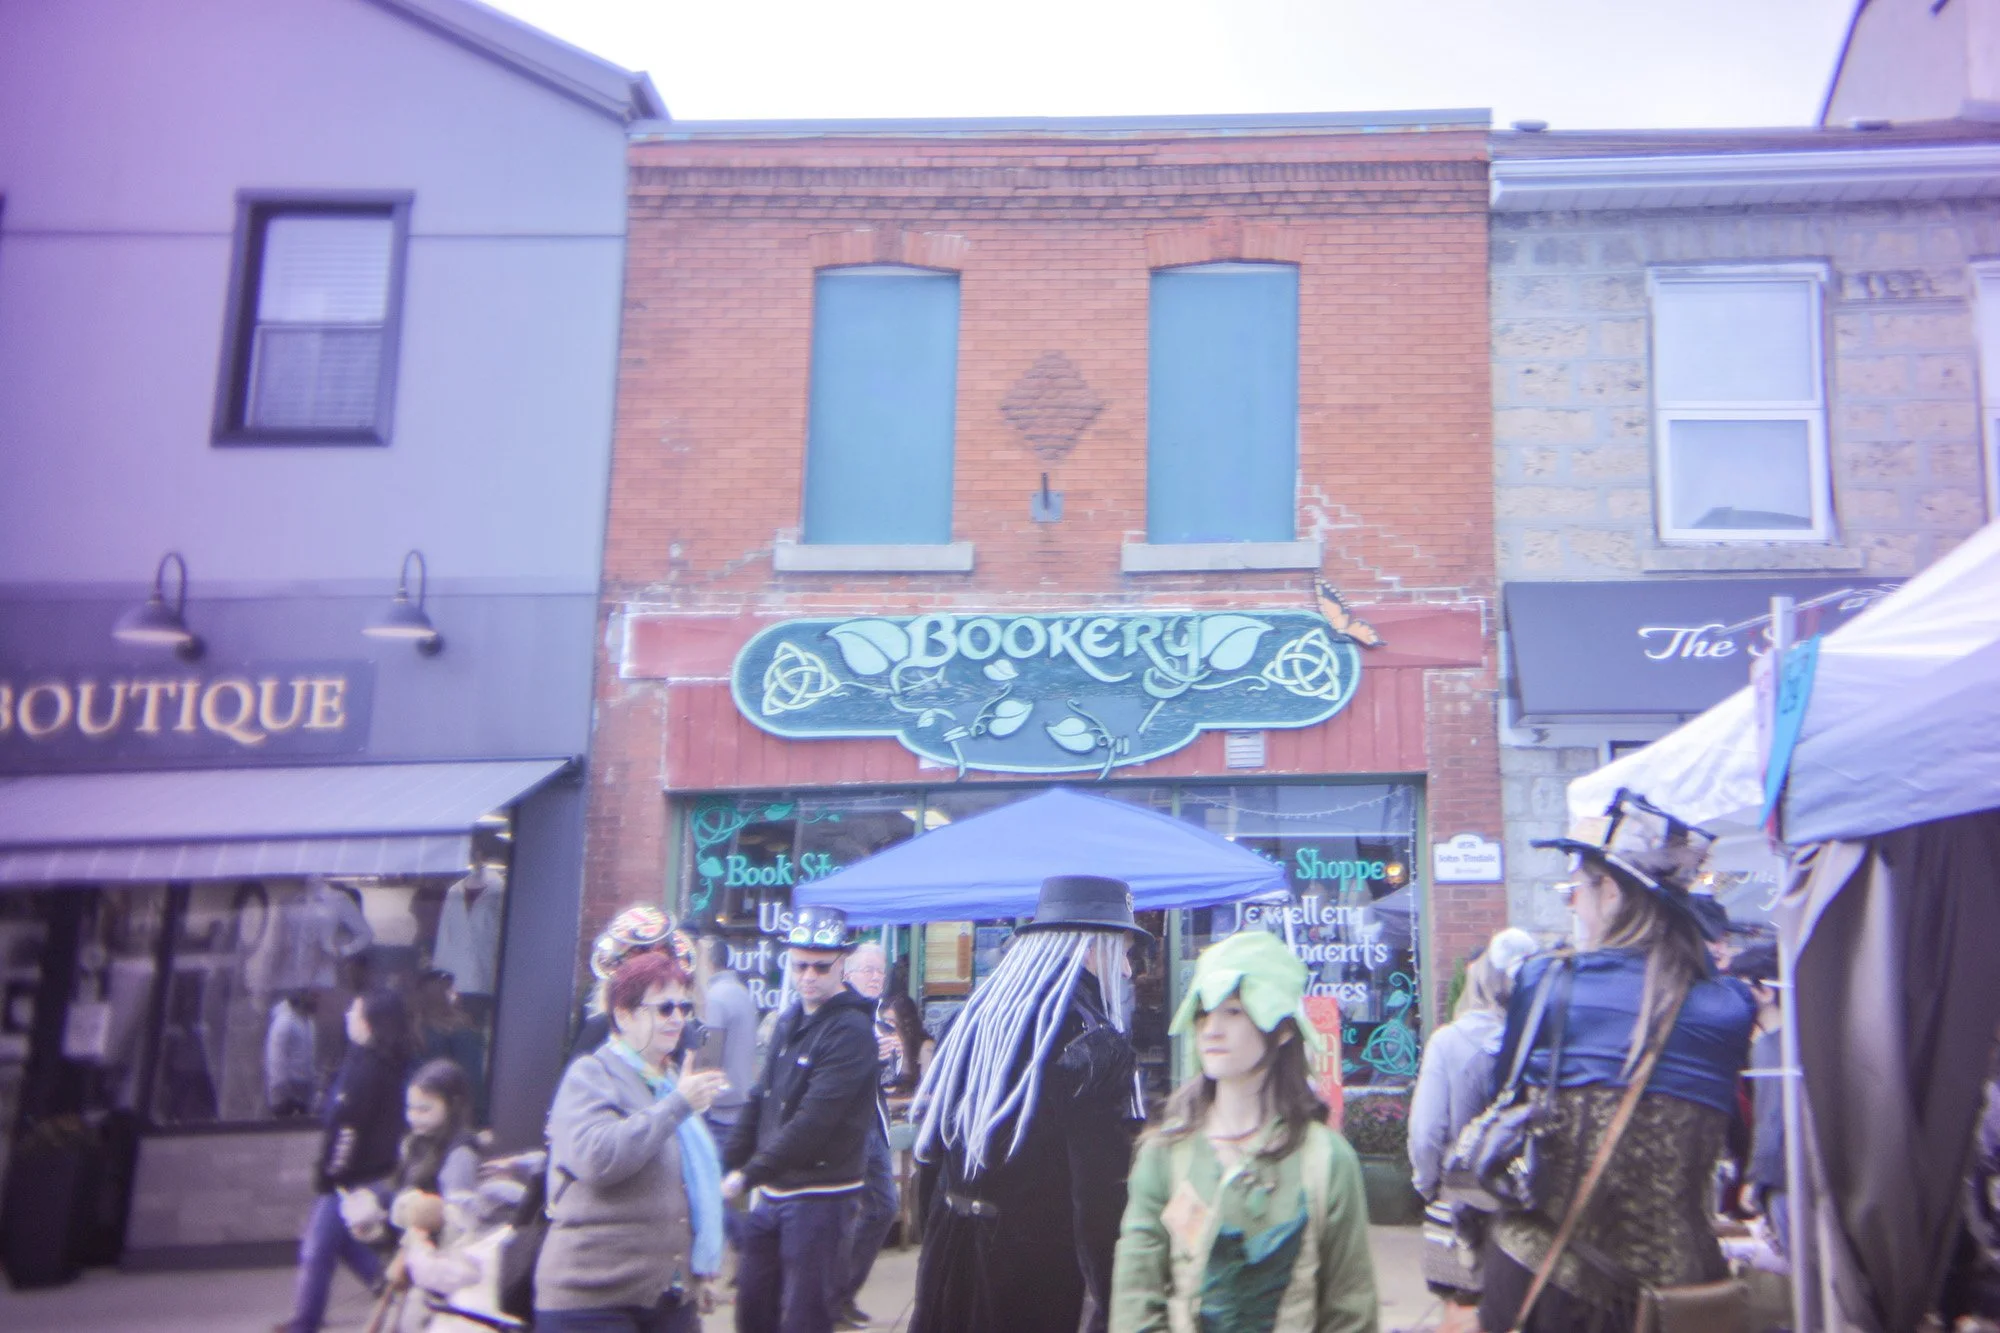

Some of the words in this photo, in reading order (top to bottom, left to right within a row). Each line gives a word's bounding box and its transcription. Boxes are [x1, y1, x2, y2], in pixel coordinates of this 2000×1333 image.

[890, 613, 1212, 698] BOOKERY
[1637, 624, 1738, 660] The
[724, 854, 794, 887] Book
[1296, 847, 1386, 892] Shoppe
